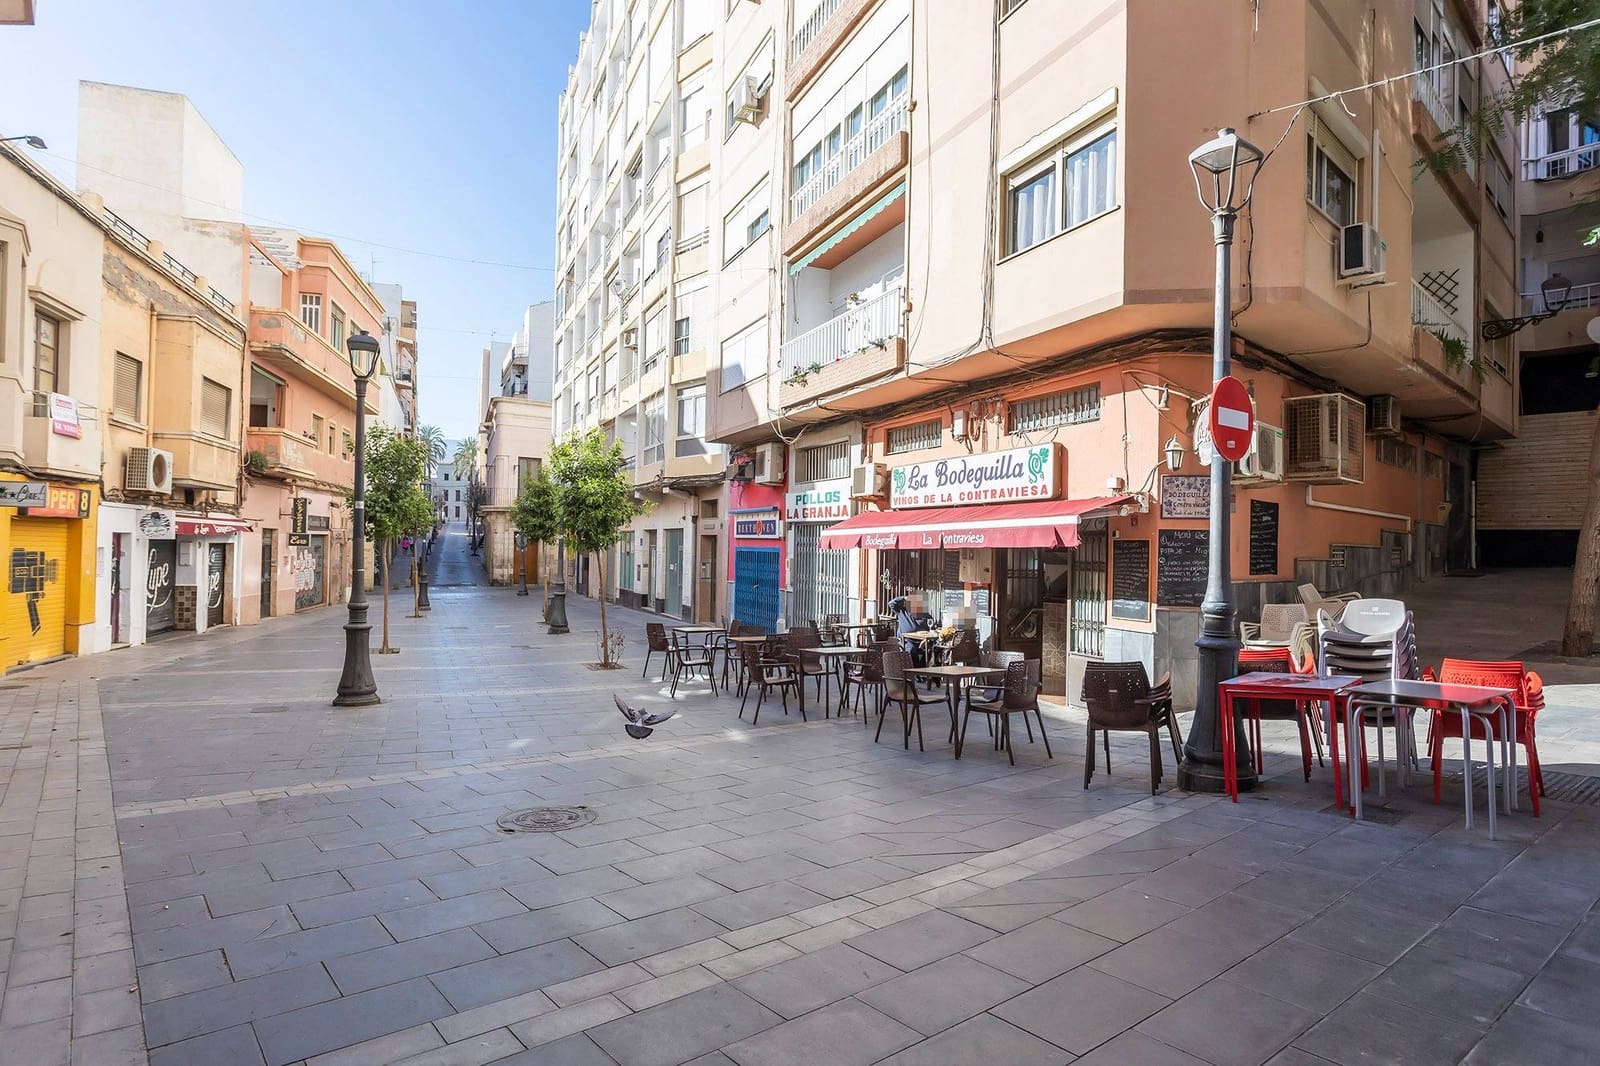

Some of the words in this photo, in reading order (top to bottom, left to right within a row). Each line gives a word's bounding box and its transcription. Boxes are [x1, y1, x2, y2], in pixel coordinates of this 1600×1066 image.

[908, 465, 928, 490] La
[935, 455, 1024, 489] Bodeguilla
[50, 489, 76, 510] PER
[80, 491, 89, 511] 8
[795, 490, 841, 505] POLLOS
[893, 496, 919, 505] VINOS
[924, 494, 936, 503] DE
[941, 493, 953, 502] LA
[959, 484, 1048, 501] CONTRAVIESA
[786, 508, 799, 519] LA
[802, 505, 849, 518] GRANJA
[738, 521, 775, 533] BEETHVEN
[922, 533, 933, 545] La
